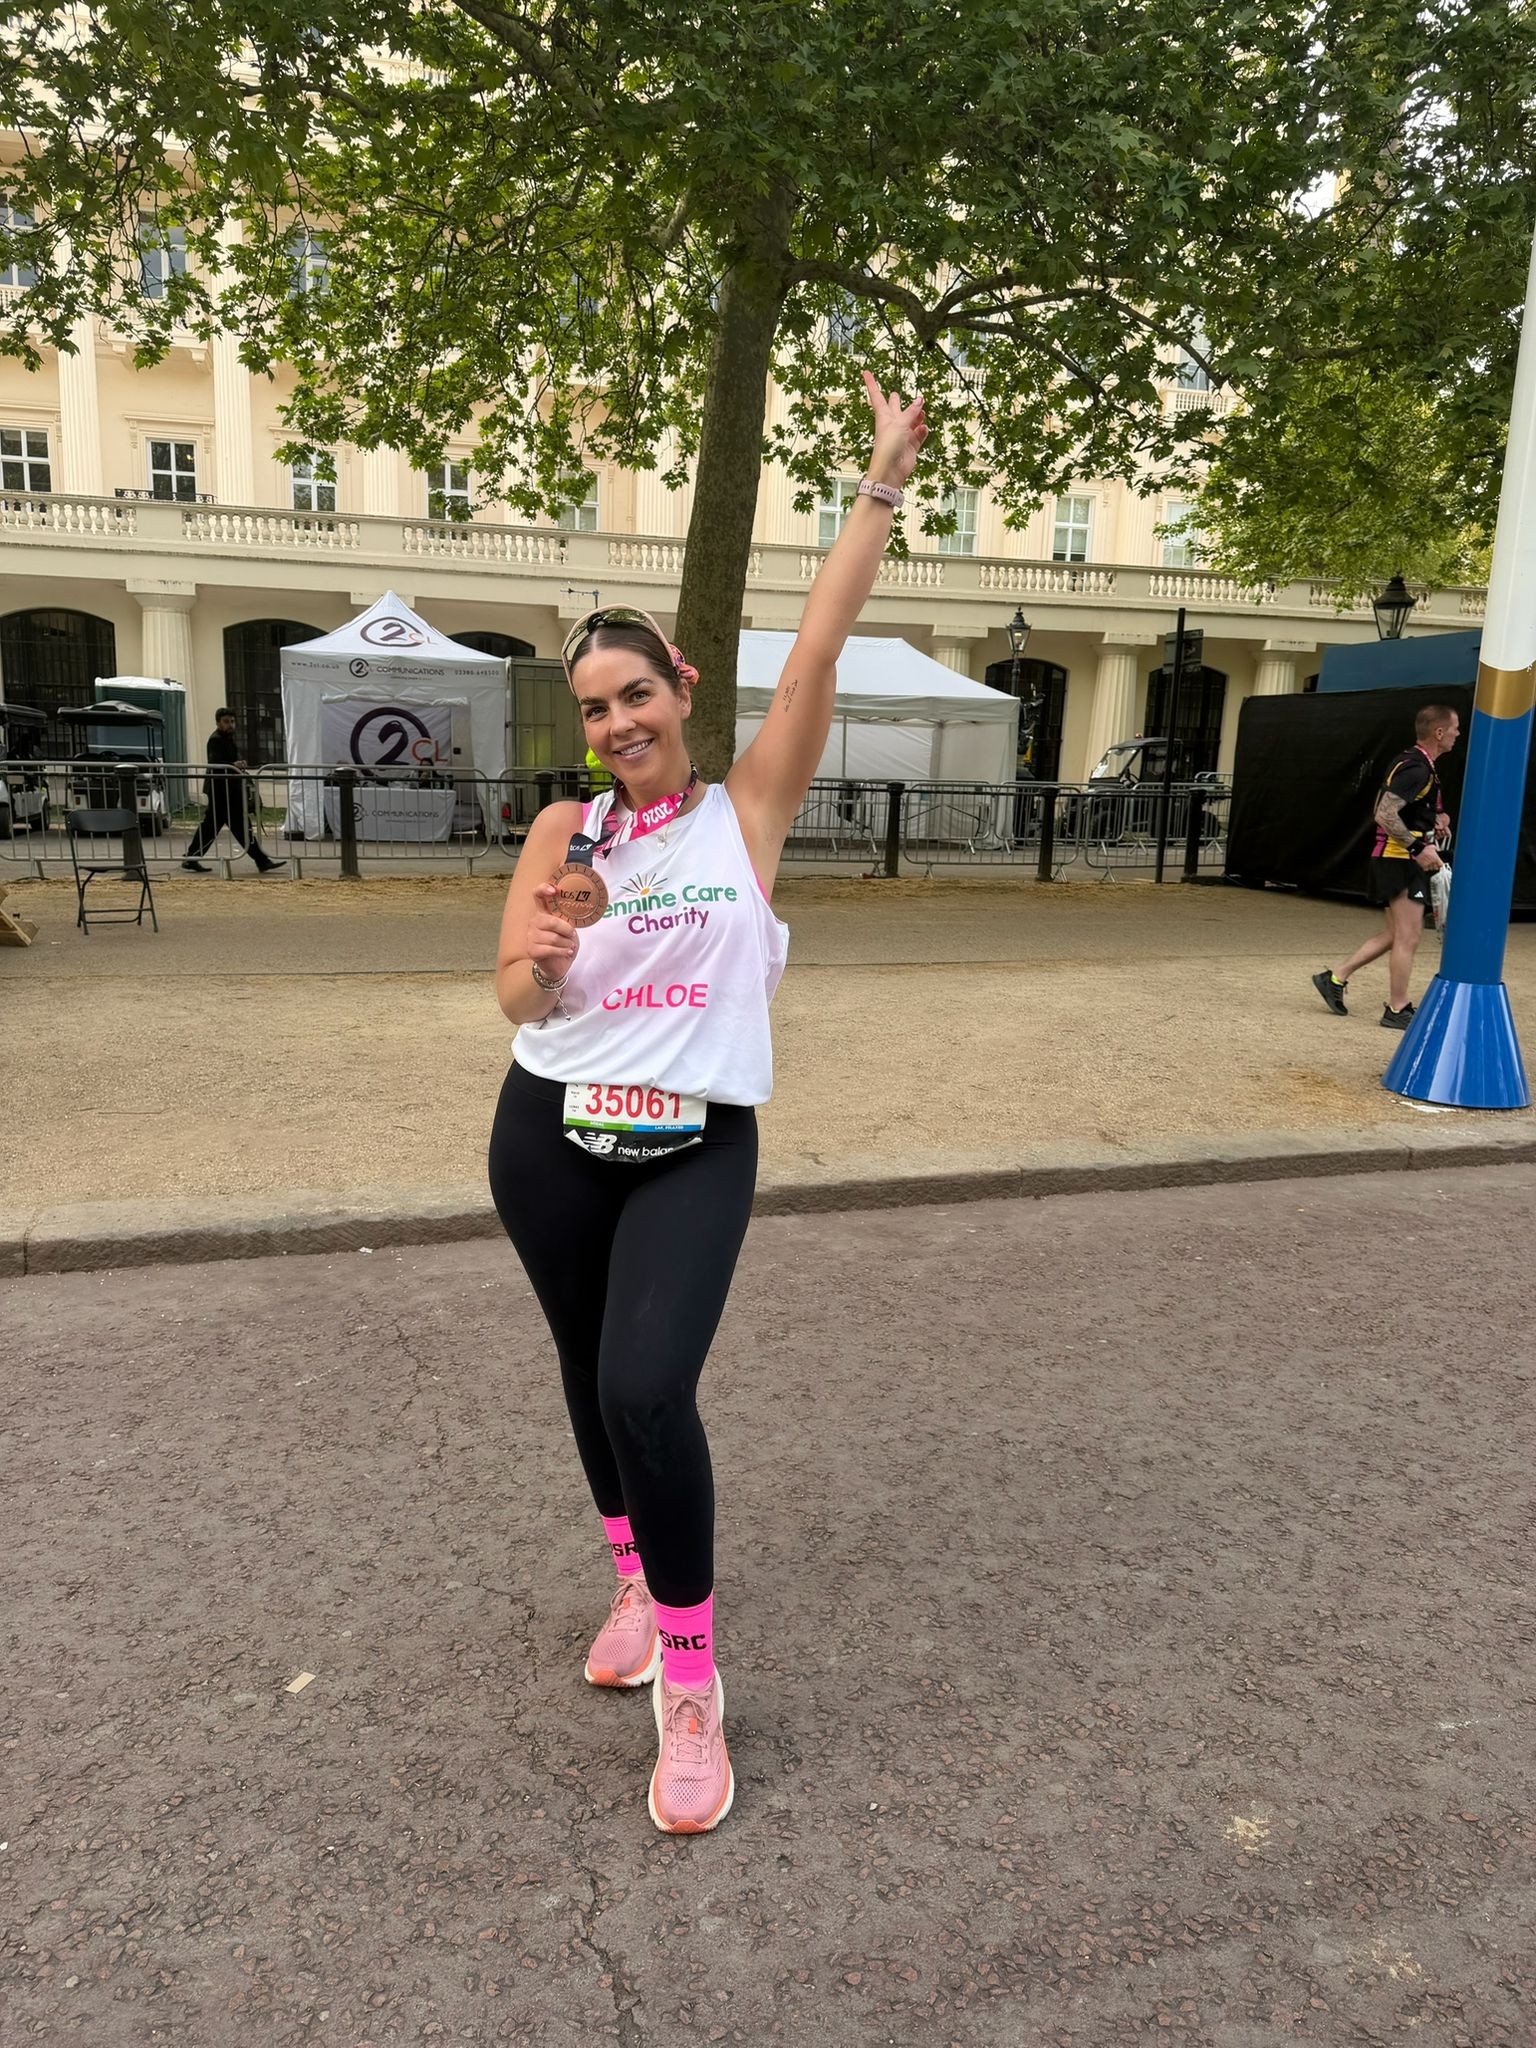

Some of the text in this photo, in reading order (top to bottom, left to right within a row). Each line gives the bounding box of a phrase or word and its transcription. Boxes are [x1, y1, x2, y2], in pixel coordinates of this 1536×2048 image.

[376, 666, 446, 676] COMMUNICATIONS
[371, 810, 440, 818] COMMUNICATIONS
[641, 802, 674, 827] 2026
[603, 885, 738, 919] ennine Care
[628, 907, 709, 934] Charity
[602, 984, 709, 1011] CHLOE
[585, 1084, 680, 1119] 35061
[617, 1146, 640, 1157] new
[659, 1629, 707, 1651] SRC
